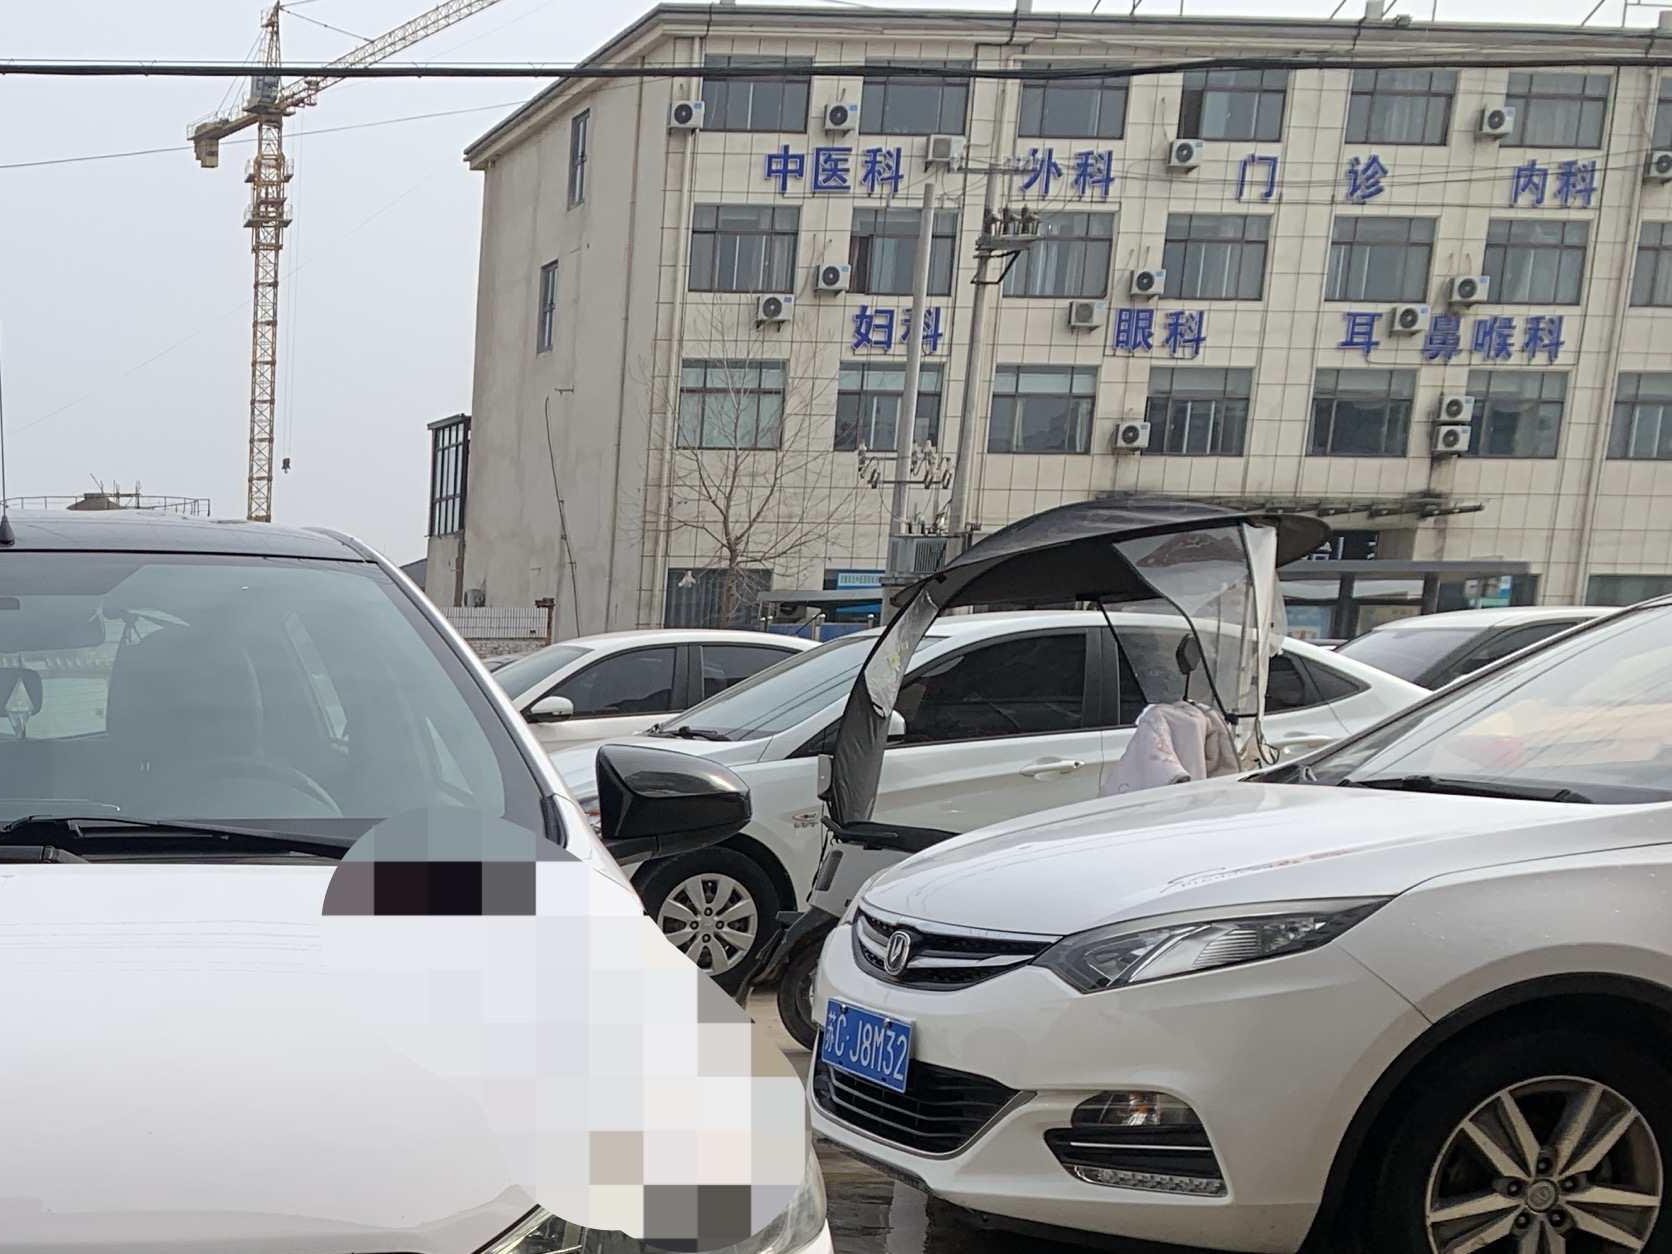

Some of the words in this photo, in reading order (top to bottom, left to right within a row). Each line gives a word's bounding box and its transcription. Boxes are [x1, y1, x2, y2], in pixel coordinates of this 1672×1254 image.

[765, 144, 905, 195] 中医科
[1021, 147, 1115, 198] 外科
[1238, 152, 1389, 201] 门诊
[1512, 158, 1598, 207] 内科
[853, 305, 944, 355] 妇科
[1114, 307, 1207, 357] 眼科
[1338, 311, 1565, 363] 耳鼻喉科
